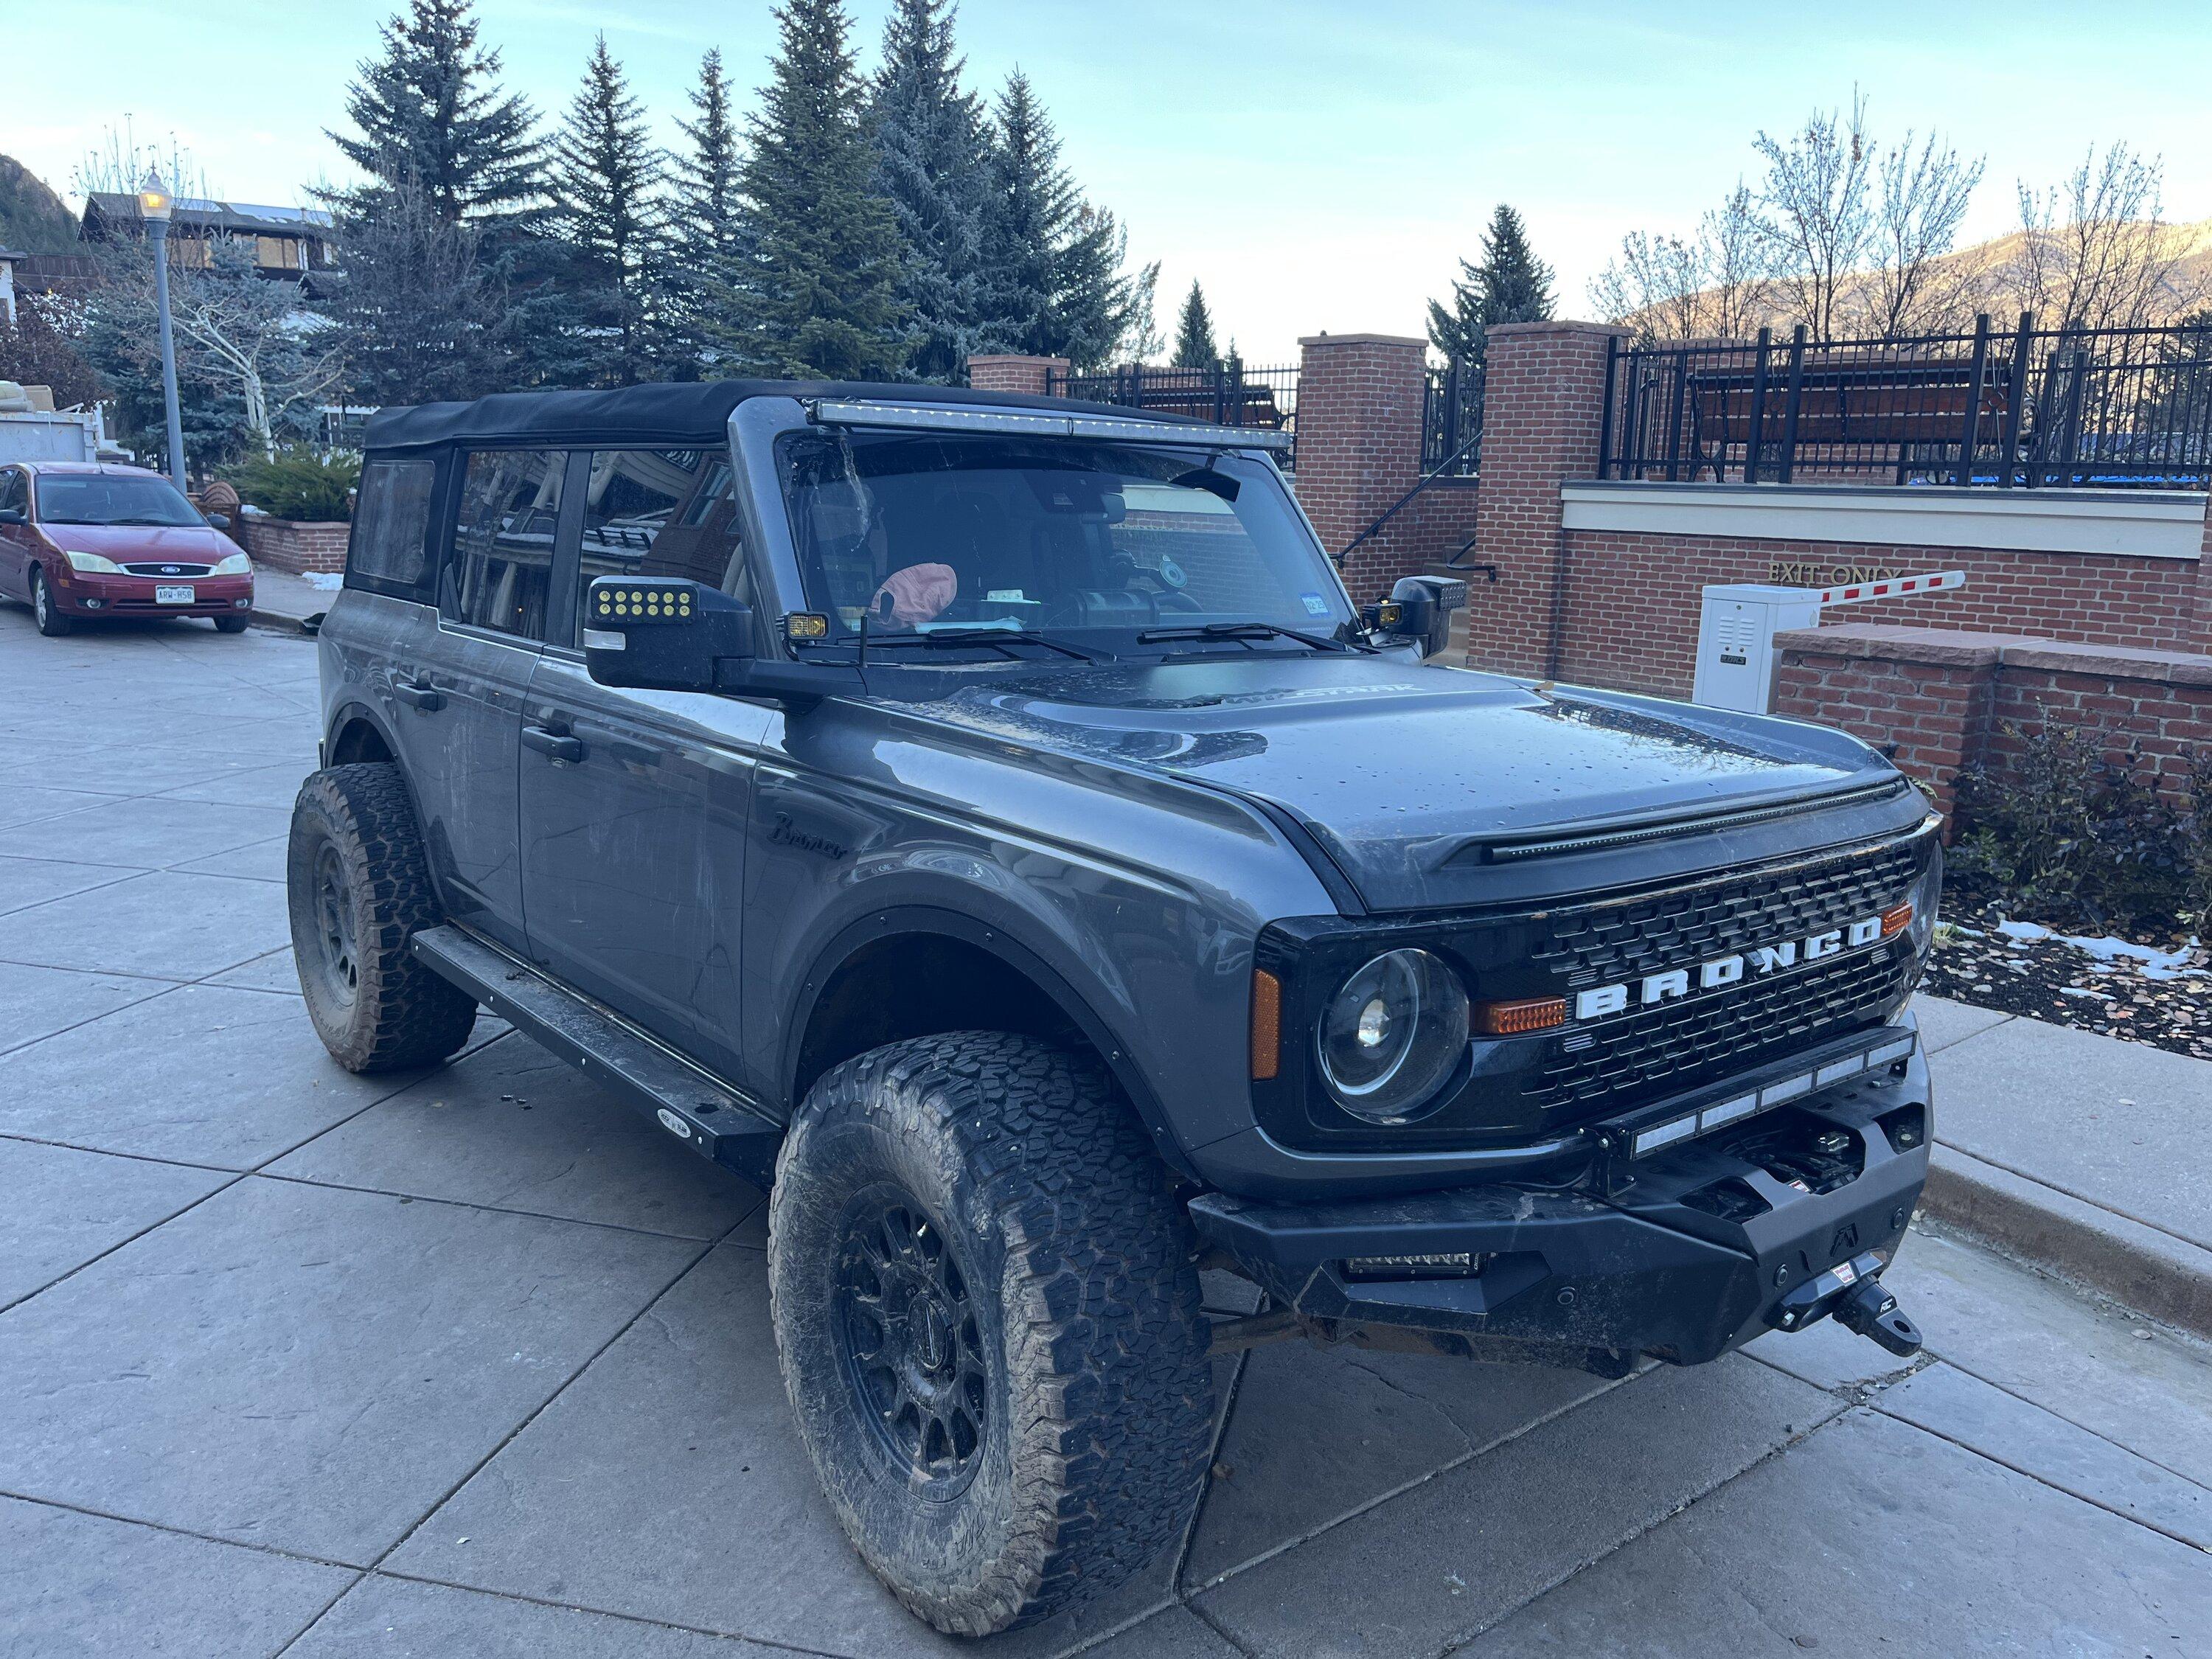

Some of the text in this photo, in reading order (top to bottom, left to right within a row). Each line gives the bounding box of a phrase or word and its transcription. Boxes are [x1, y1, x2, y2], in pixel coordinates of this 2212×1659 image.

[1769, 563, 1902, 586] EXIT ONLY
[768, 810, 848, 860] Bronco
[1576, 917, 1882, 1020] BRONCO
